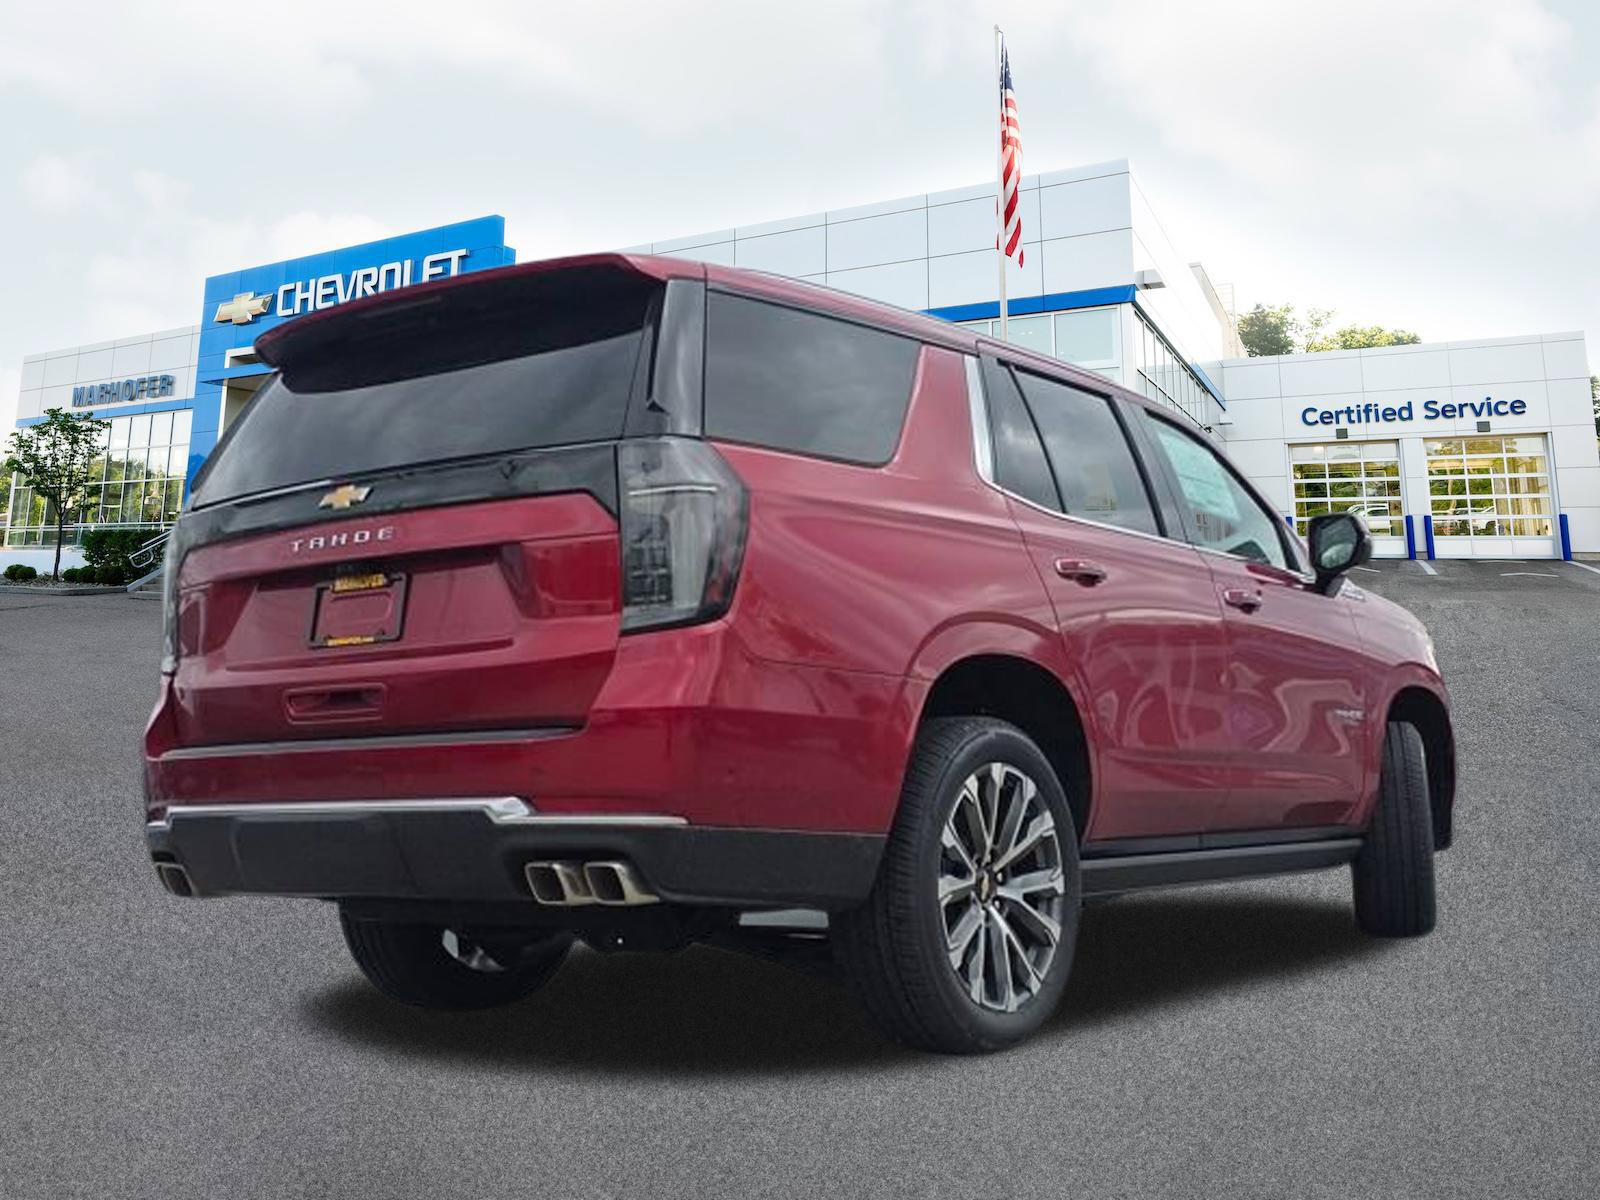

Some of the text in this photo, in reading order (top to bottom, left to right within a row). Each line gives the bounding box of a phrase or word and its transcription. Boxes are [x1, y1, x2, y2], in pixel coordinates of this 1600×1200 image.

[277, 248, 470, 317] CHEVROLET
[72, 375, 175, 407] MARHOFER
[1301, 396, 1528, 427] Certified Service
[290, 525, 395, 553] TAHOE
